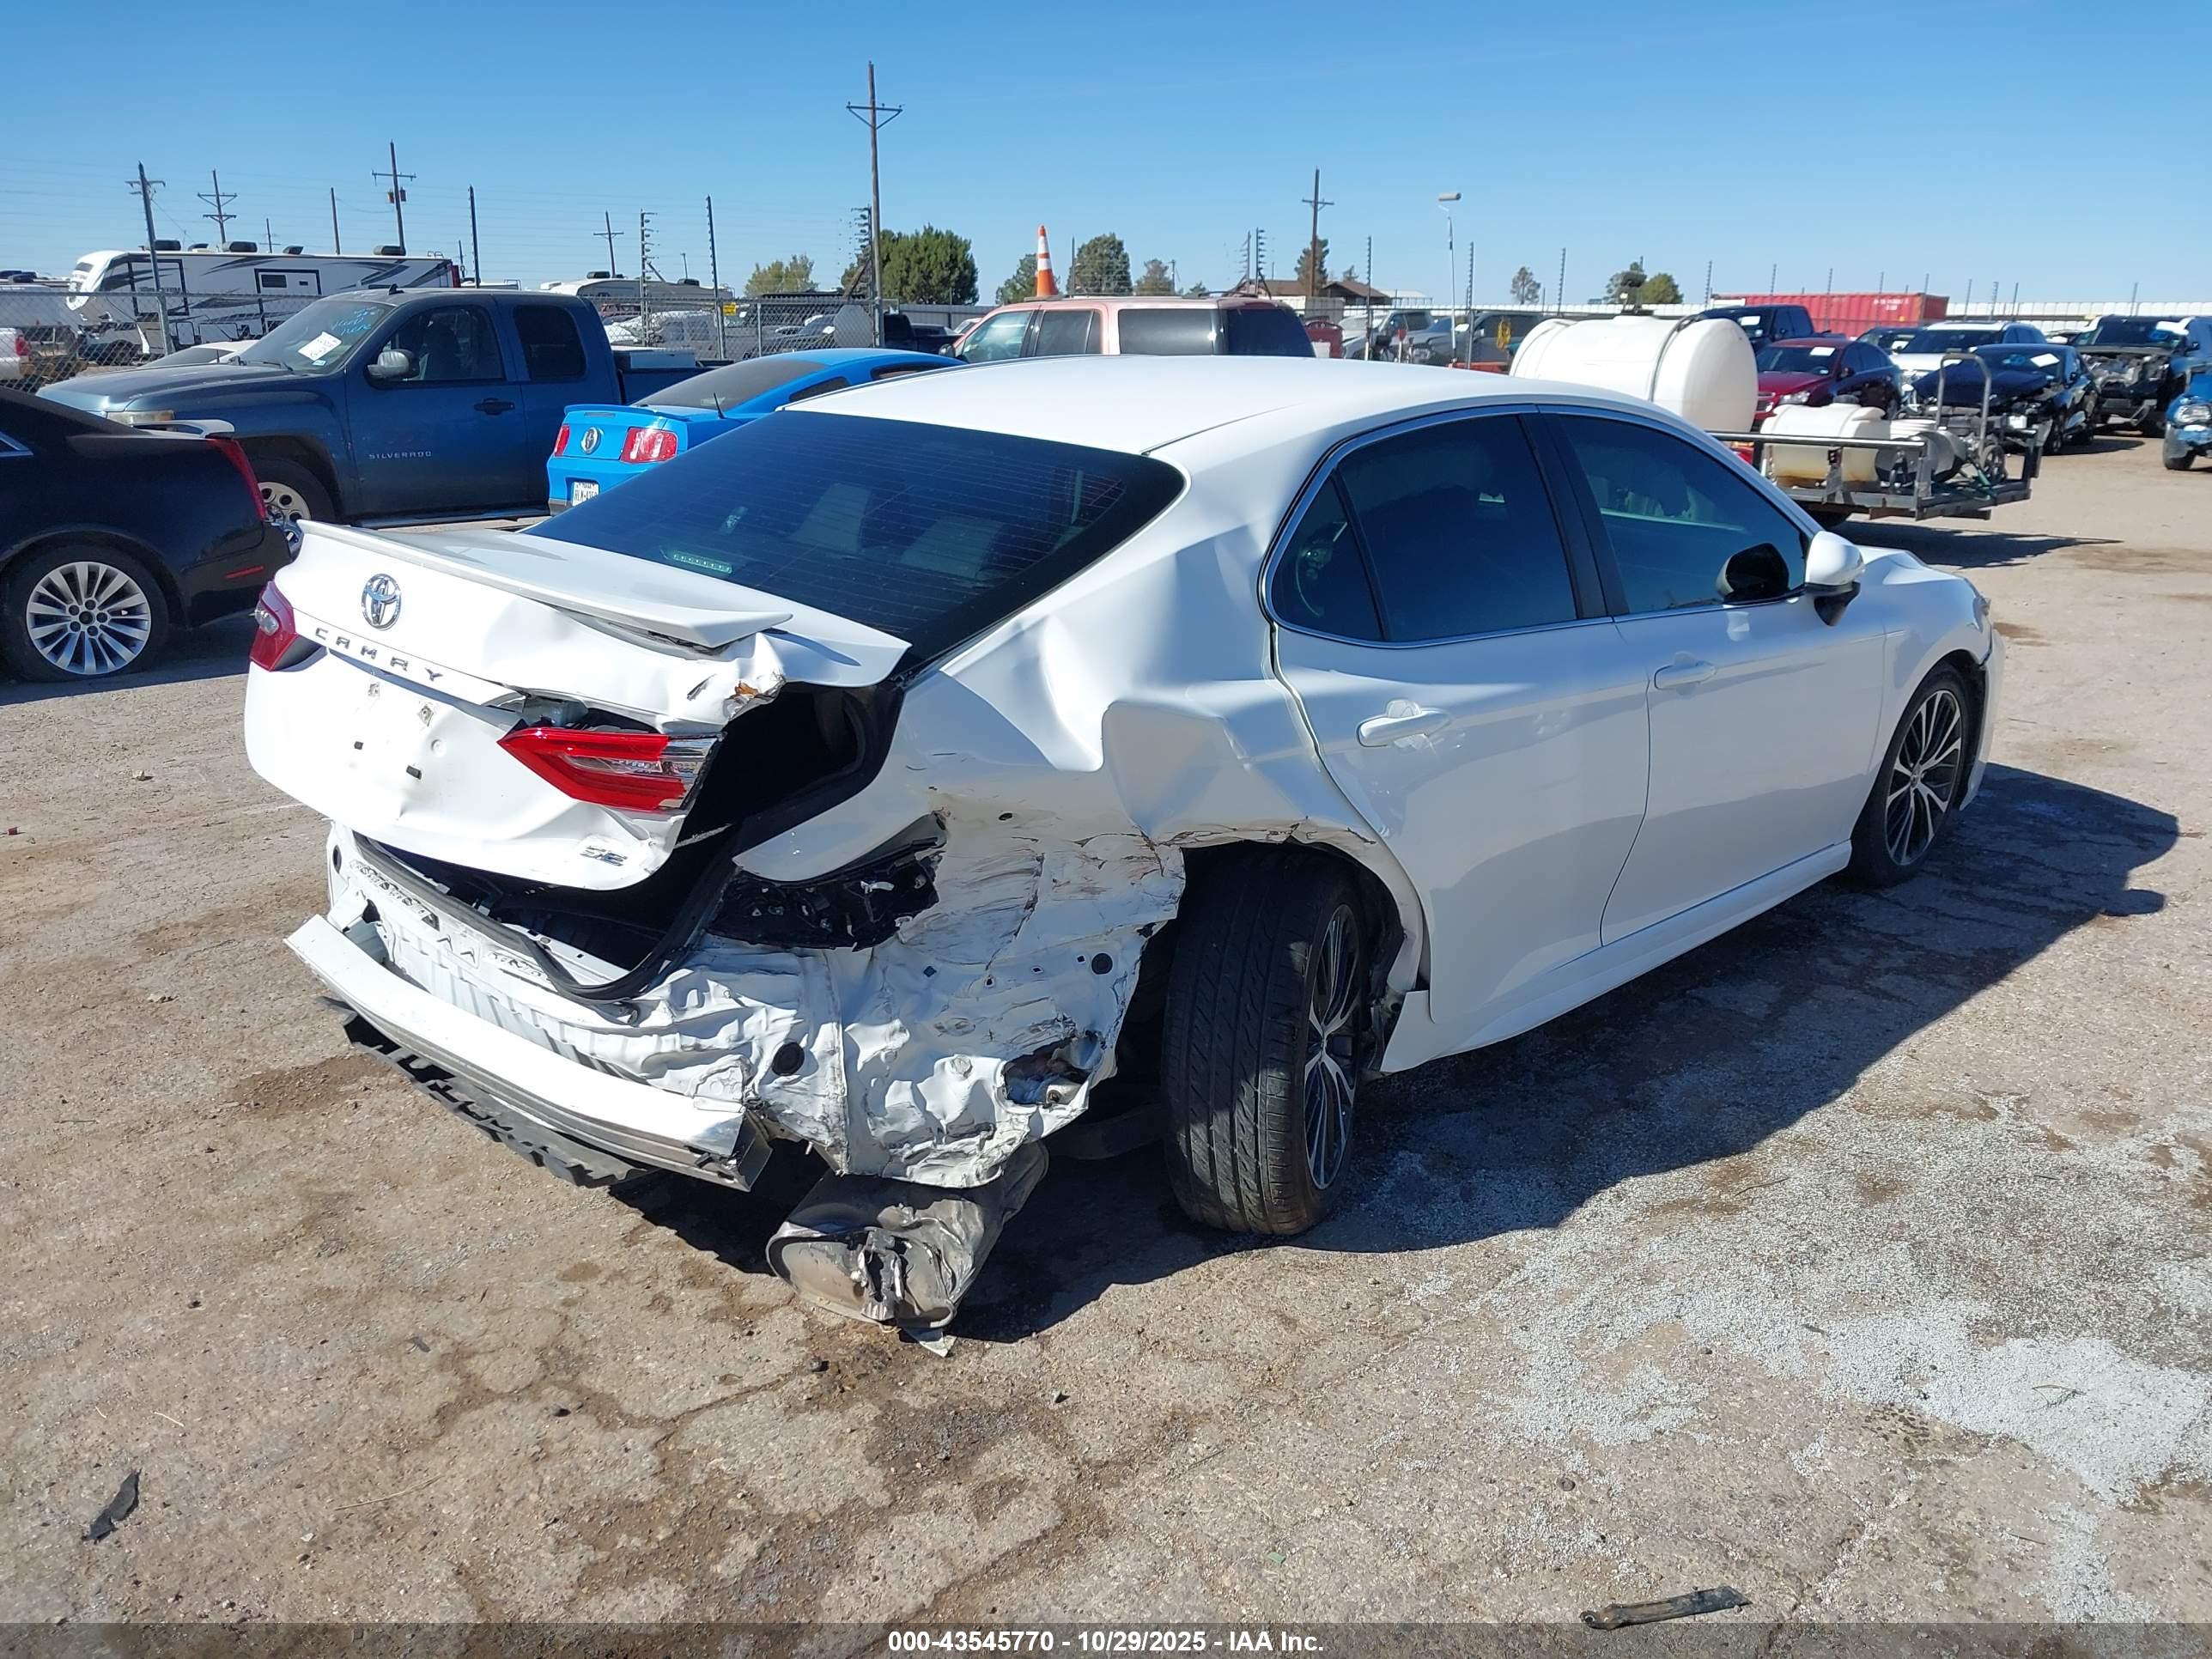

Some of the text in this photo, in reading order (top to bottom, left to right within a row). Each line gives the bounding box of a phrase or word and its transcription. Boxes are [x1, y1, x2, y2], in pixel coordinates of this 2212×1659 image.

[368, 451, 432, 460] SILVERADO
[314, 627, 444, 682] CAMRY
[580, 846, 628, 866] SE
